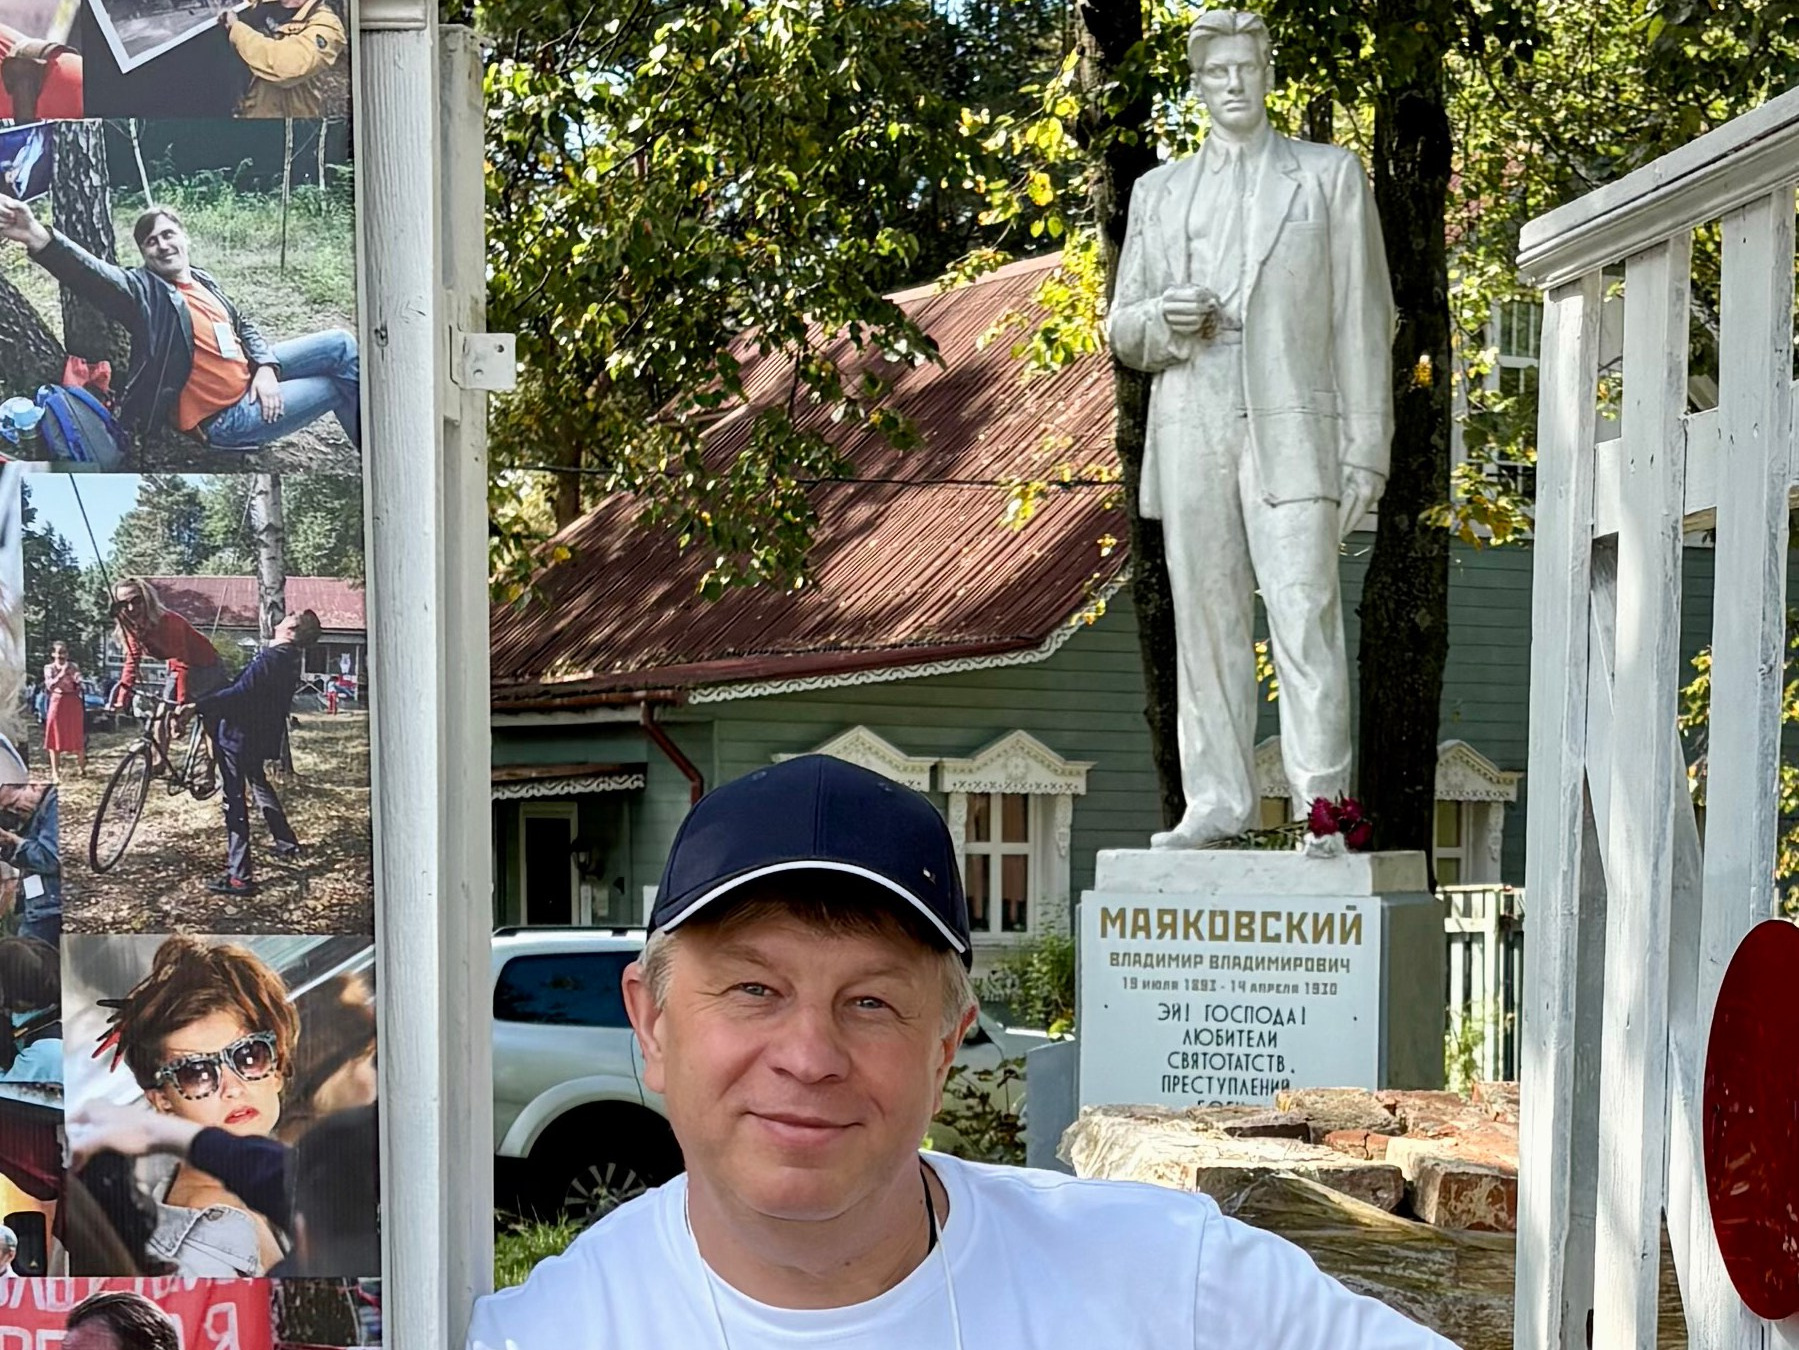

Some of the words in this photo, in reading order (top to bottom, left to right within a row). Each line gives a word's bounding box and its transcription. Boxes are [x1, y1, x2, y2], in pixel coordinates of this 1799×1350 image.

[1100, 905, 1362, 945] МАЯКОВСКИЙ
[1109, 952, 1203, 969] ВЛАДИМИР
[1209, 954, 1351, 973] ВЛАДИМИРОВИЧ
[1122, 977, 1138, 990] 19
[1184, 978, 1217, 992] 1893
[1230, 980, 1246, 993] 14
[1305, 982, 1338, 996] 1930
[1157, 1003, 1190, 1021] ЭЙ!
[1205, 1004, 1306, 1026] ГОСПОДА!
[1182, 1029, 1277, 1048] ЛЮБИТЕЛИ
